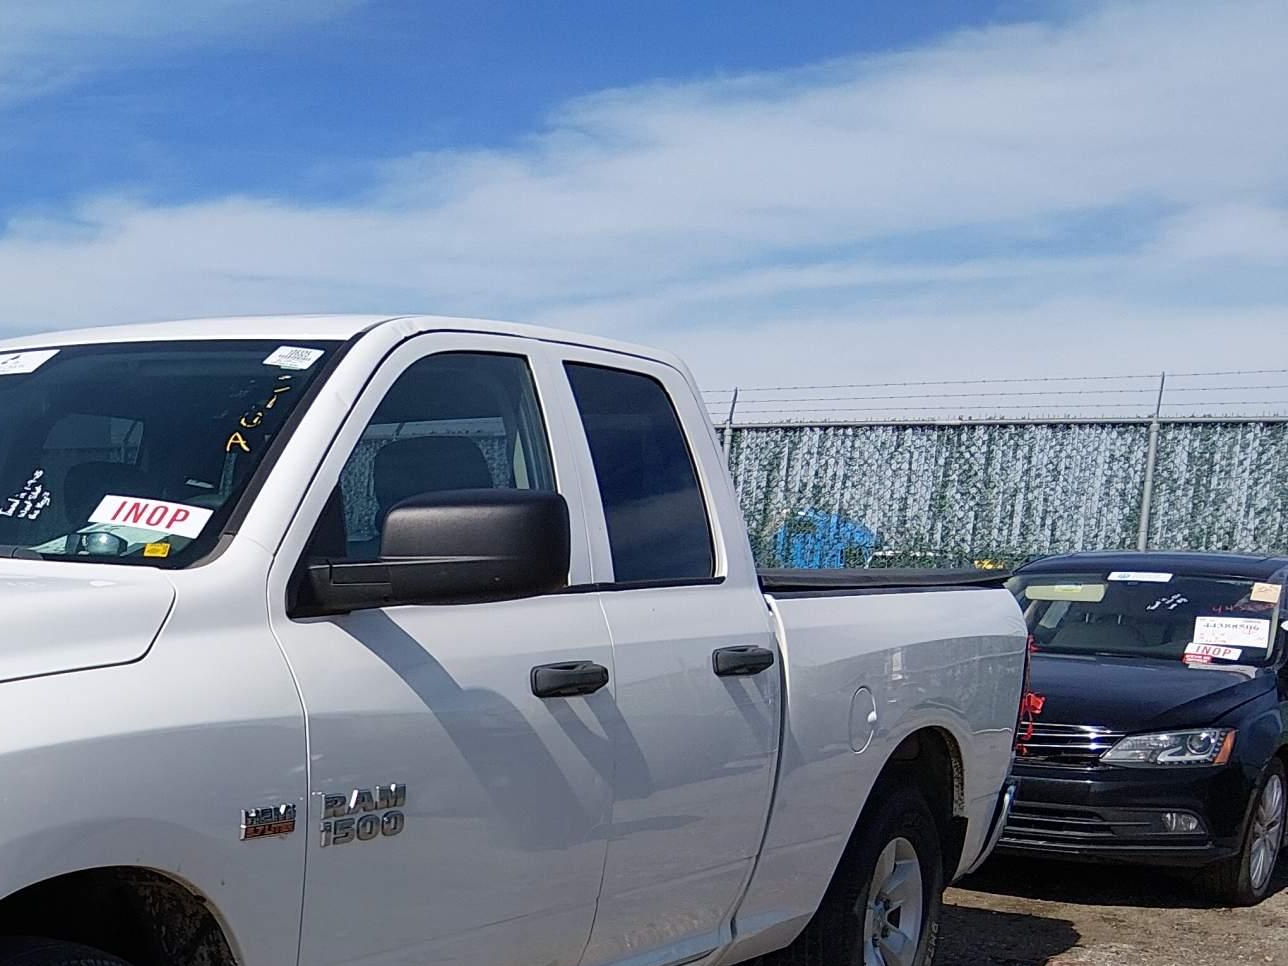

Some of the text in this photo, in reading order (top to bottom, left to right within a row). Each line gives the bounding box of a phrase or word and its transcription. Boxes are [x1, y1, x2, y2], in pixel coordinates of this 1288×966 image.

[110, 501, 191, 529] INOP
[1195, 645, 1232, 657] INOP
[320, 783, 407, 821] RAM
[319, 810, 405, 848] 1500
